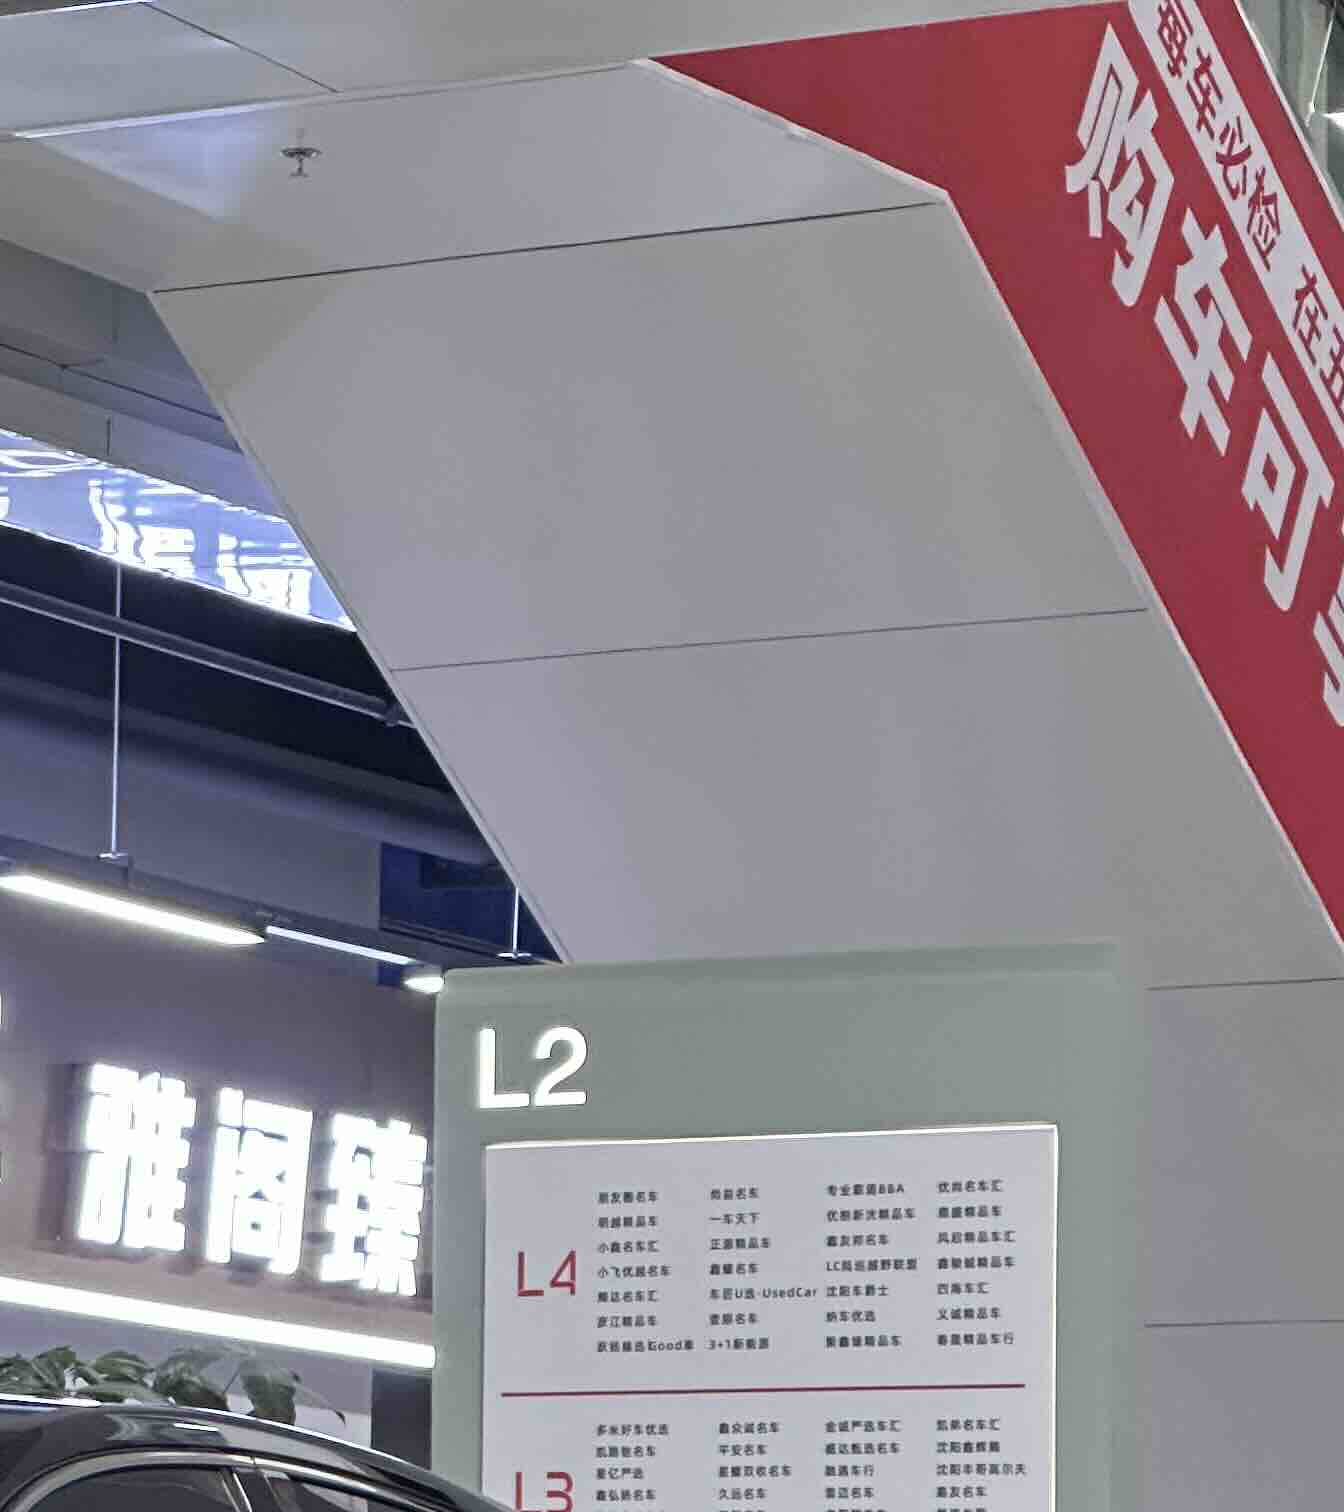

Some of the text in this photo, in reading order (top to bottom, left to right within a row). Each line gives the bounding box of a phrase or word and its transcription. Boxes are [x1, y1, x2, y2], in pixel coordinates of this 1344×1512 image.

[478, 1026, 588, 1109] L2
[709, 1212, 760, 1225] 一车天下
[517, 1250, 576, 1296] L4
